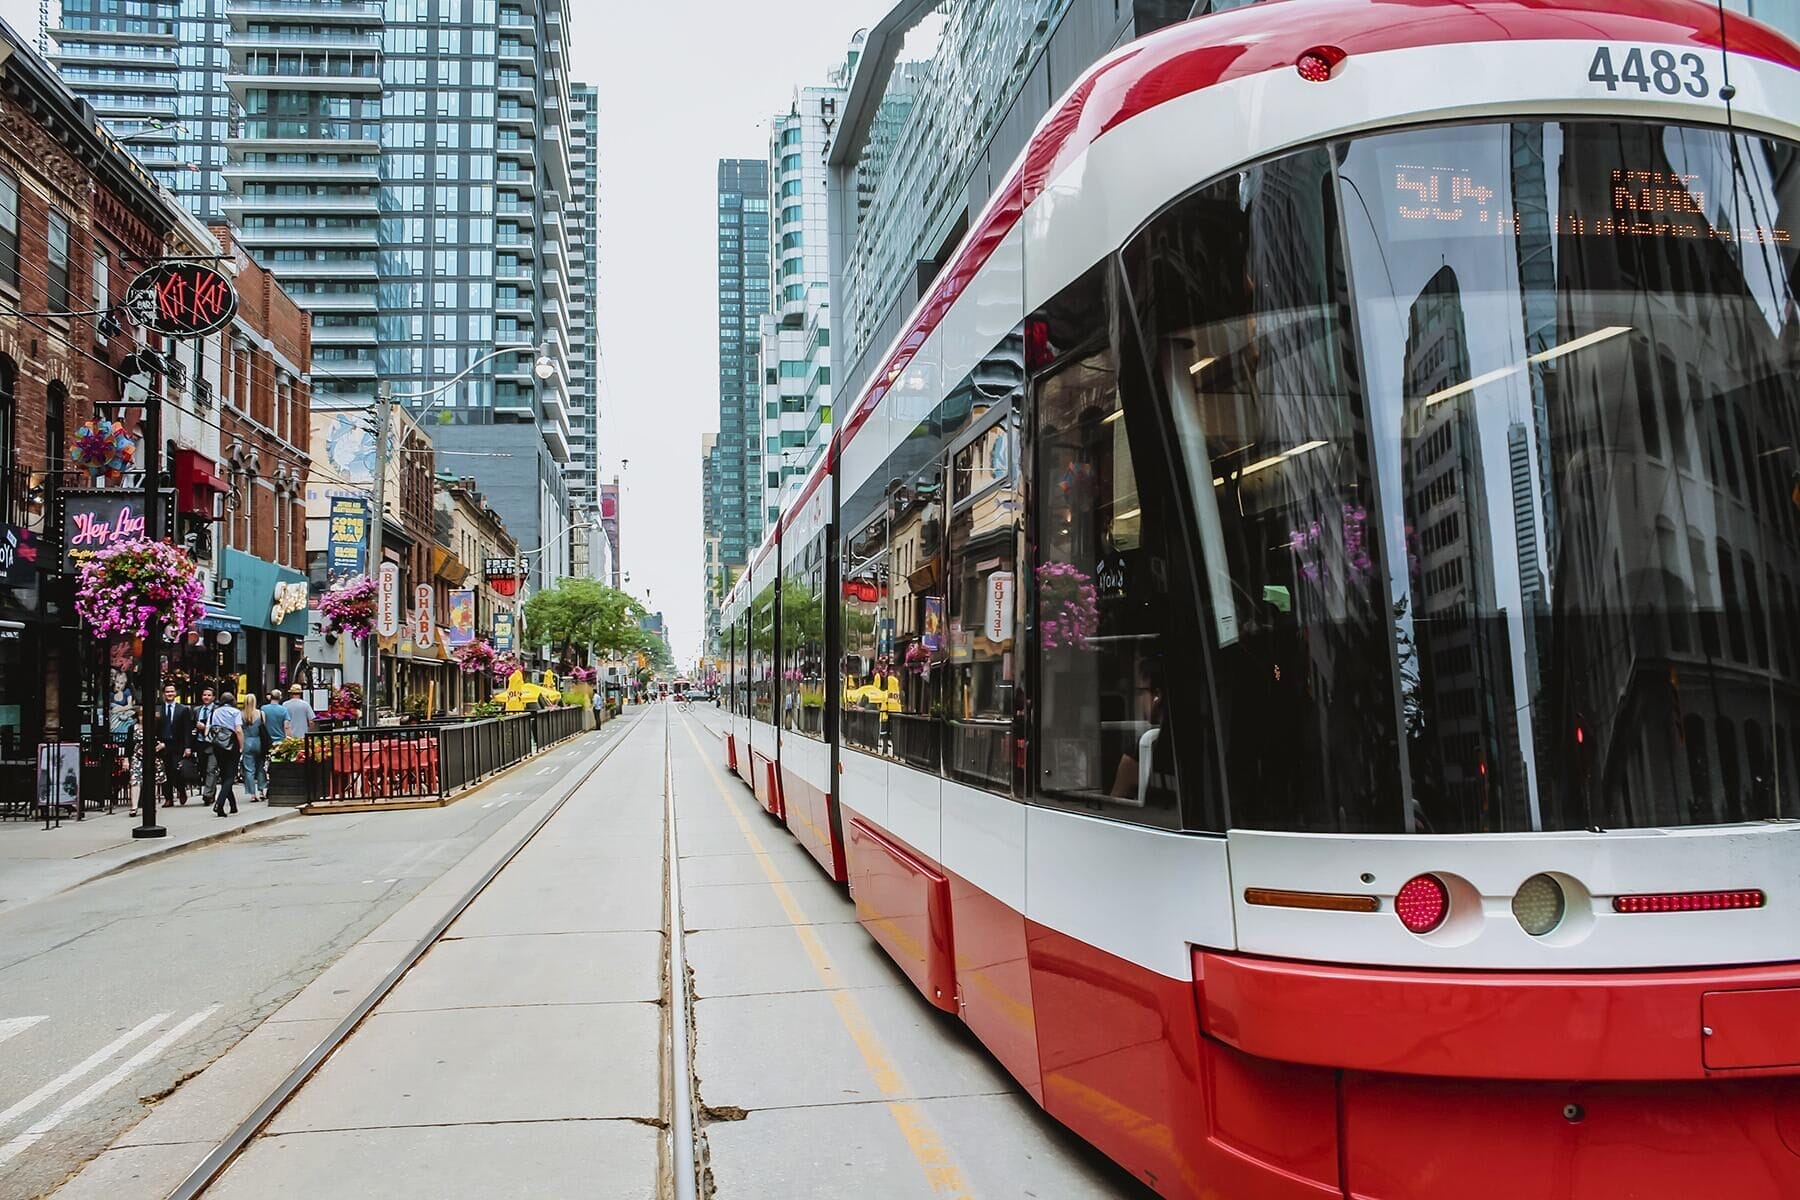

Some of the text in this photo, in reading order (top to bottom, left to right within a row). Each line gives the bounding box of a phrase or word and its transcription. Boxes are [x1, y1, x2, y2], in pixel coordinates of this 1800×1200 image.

[1588, 46, 1710, 98] 4483
[72, 506, 145, 545] Hey Luc
[383, 573, 393, 632] BUFFET
[418, 587, 430, 645] DHABA
